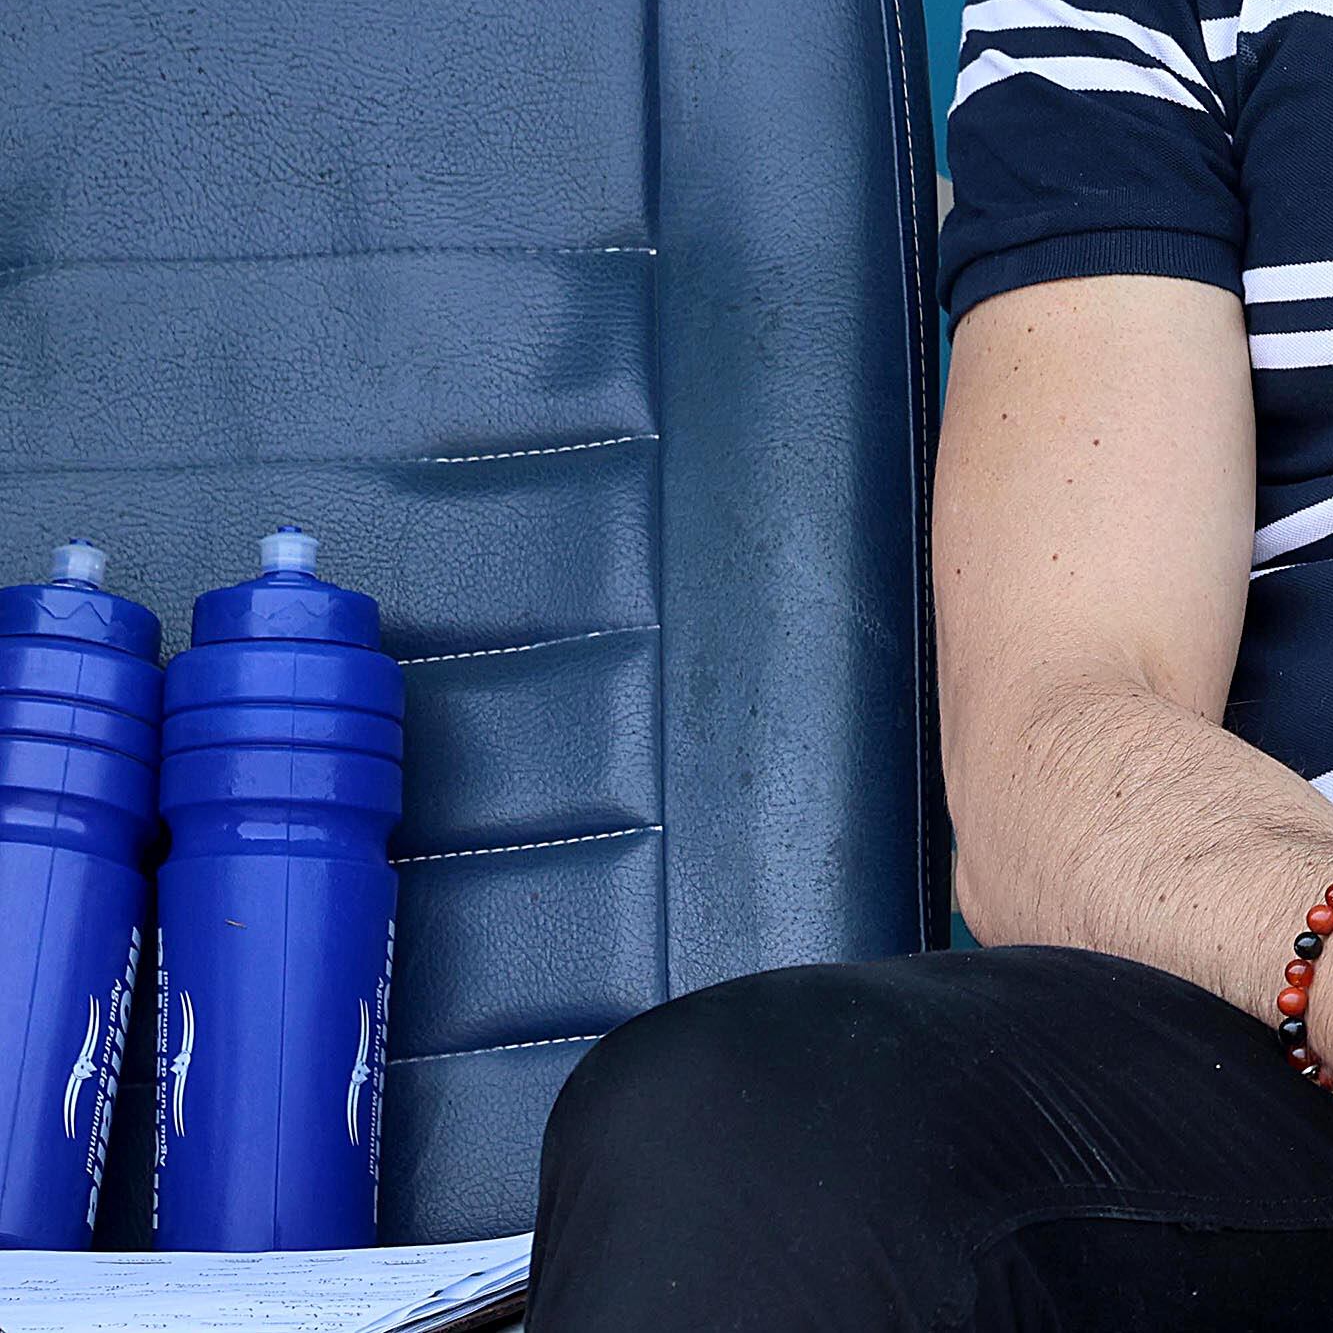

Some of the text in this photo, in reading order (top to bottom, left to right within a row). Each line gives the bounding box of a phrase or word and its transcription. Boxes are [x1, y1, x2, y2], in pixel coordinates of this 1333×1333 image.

[160, 969, 169, 1054] Manantial
[86, 978, 124, 1175] Agua Pura de Manantial
[159, 1080, 168, 1121] Pura
[158, 1123, 168, 1168] Agua
